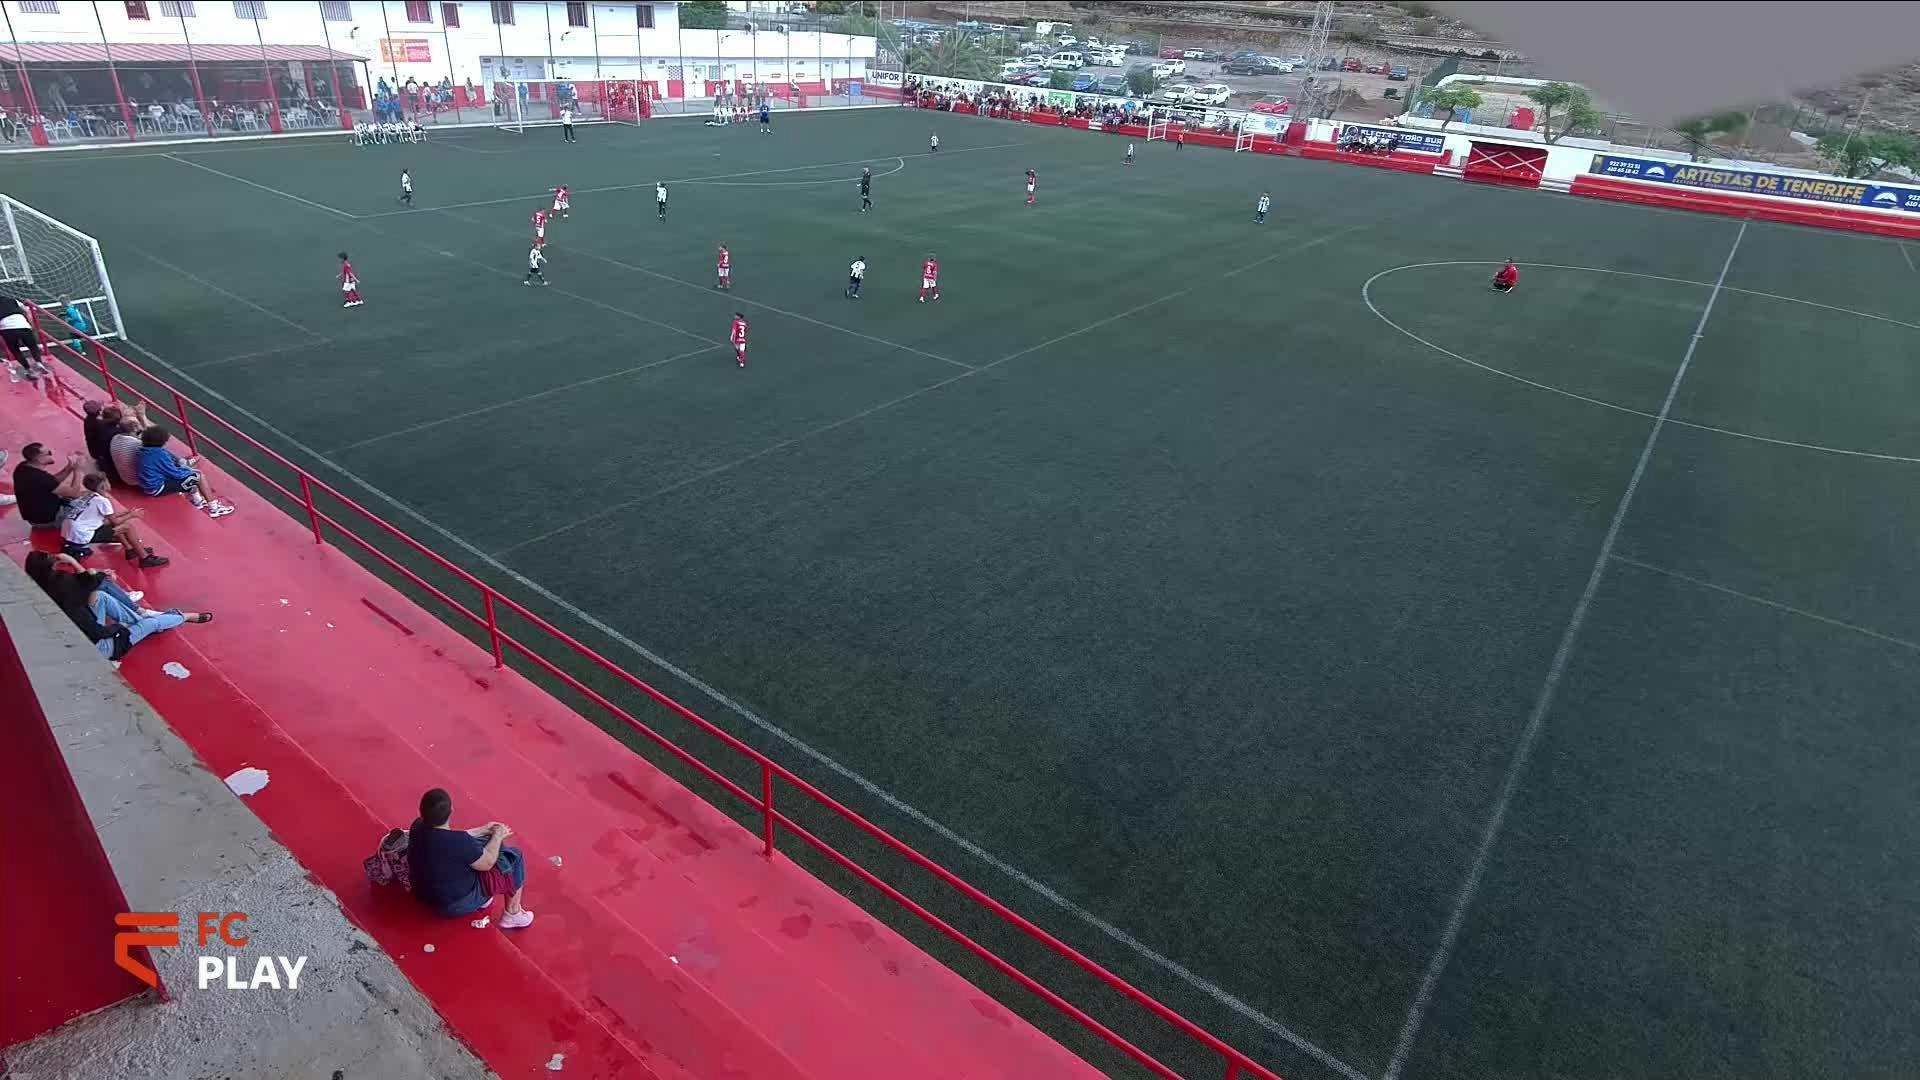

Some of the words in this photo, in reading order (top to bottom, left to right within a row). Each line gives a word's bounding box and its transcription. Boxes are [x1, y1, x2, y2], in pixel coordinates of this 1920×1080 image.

[1673, 167, 1754, 187] ARTISTAS
[1755, 175, 1780, 190] DE
[1783, 177, 1866, 200] TENERIFE
[738, 325, 745, 338] 3
